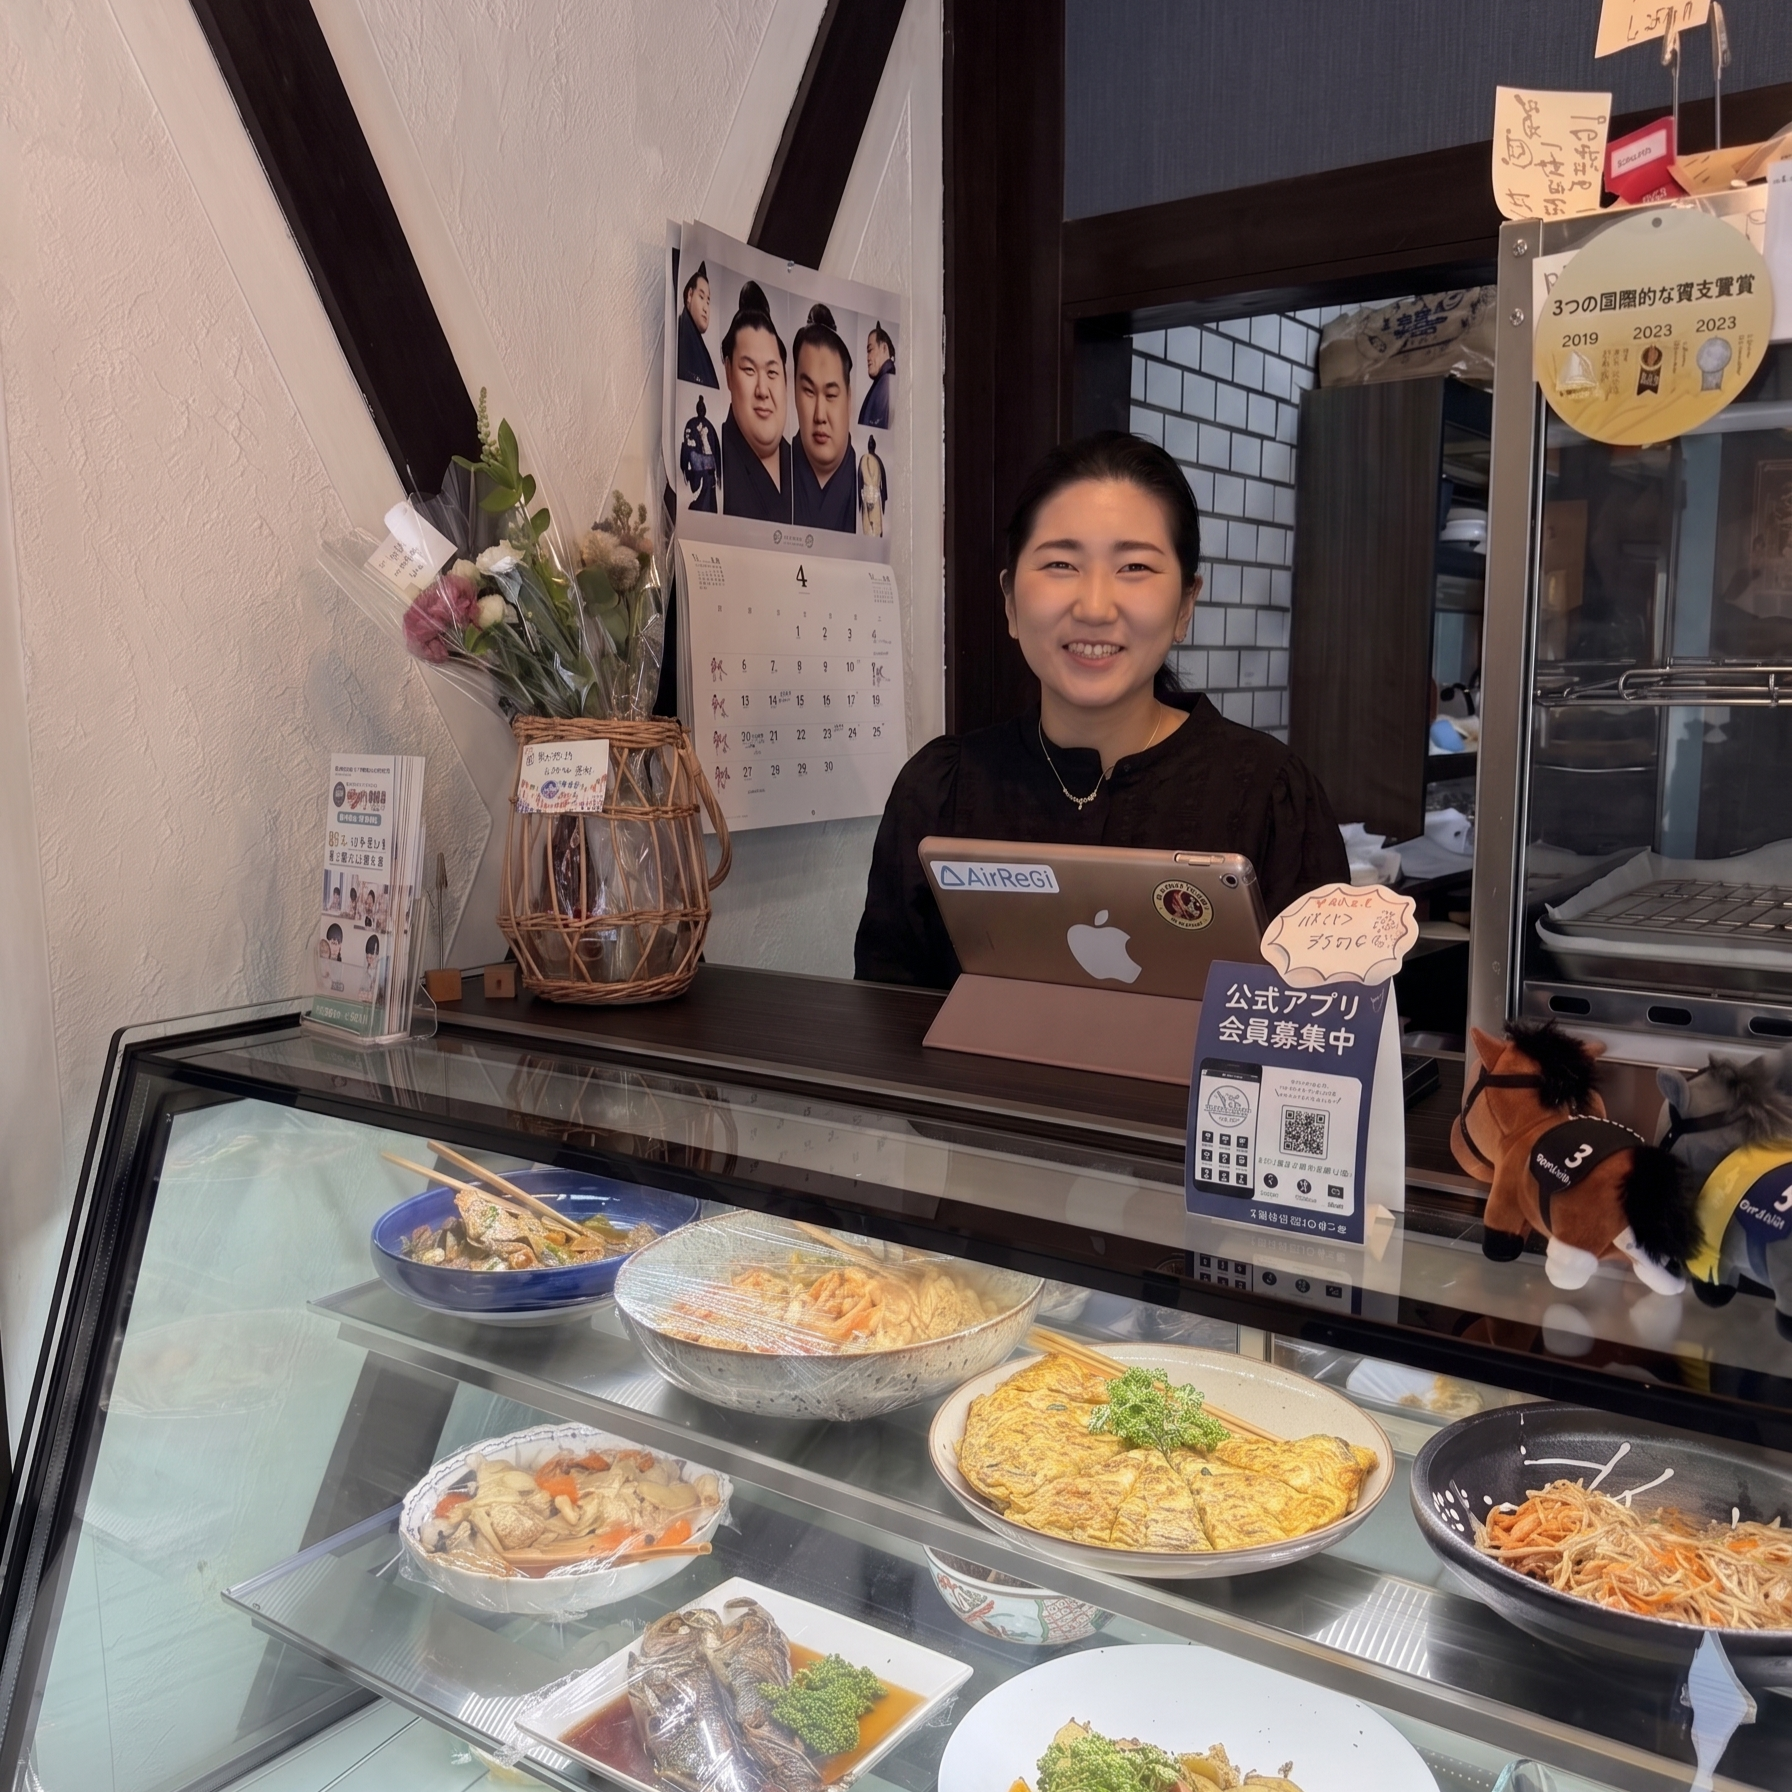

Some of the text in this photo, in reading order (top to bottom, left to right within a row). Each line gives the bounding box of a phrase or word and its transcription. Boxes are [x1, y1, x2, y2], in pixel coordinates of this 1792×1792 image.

[1562, 316, 1737, 348] 2019 2023 2023
[795, 564, 808, 588] 4
[795, 625, 800, 637] 1
[822, 626, 828, 638] 2
[847, 628, 852, 639] 3
[741, 658, 747, 670] 6
[770, 659, 776, 672] 7
[797, 660, 802, 671] 8
[823, 661, 828, 672] 9
[846, 661, 855, 672] 10
[741, 695, 750, 706] 13
[768, 695, 778, 706] 14
[796, 694, 805, 706] 15
[822, 694, 831, 706] 16
[847, 694, 856, 705] 17
[769, 730, 778, 741] 21
[796, 729, 806, 740] 22
[822, 728, 832, 739] 23
[848, 727, 857, 738] 24
[872, 726, 882, 737] 25
[742, 766, 753, 778] 27
[770, 764, 780, 776] 28
[824, 761, 834, 772] 30
[1225, 983, 1359, 1021] 公式アプリ
[1219, 1015, 1355, 1056] 会員募集中
[1564, 1143, 1594, 1168] 3
